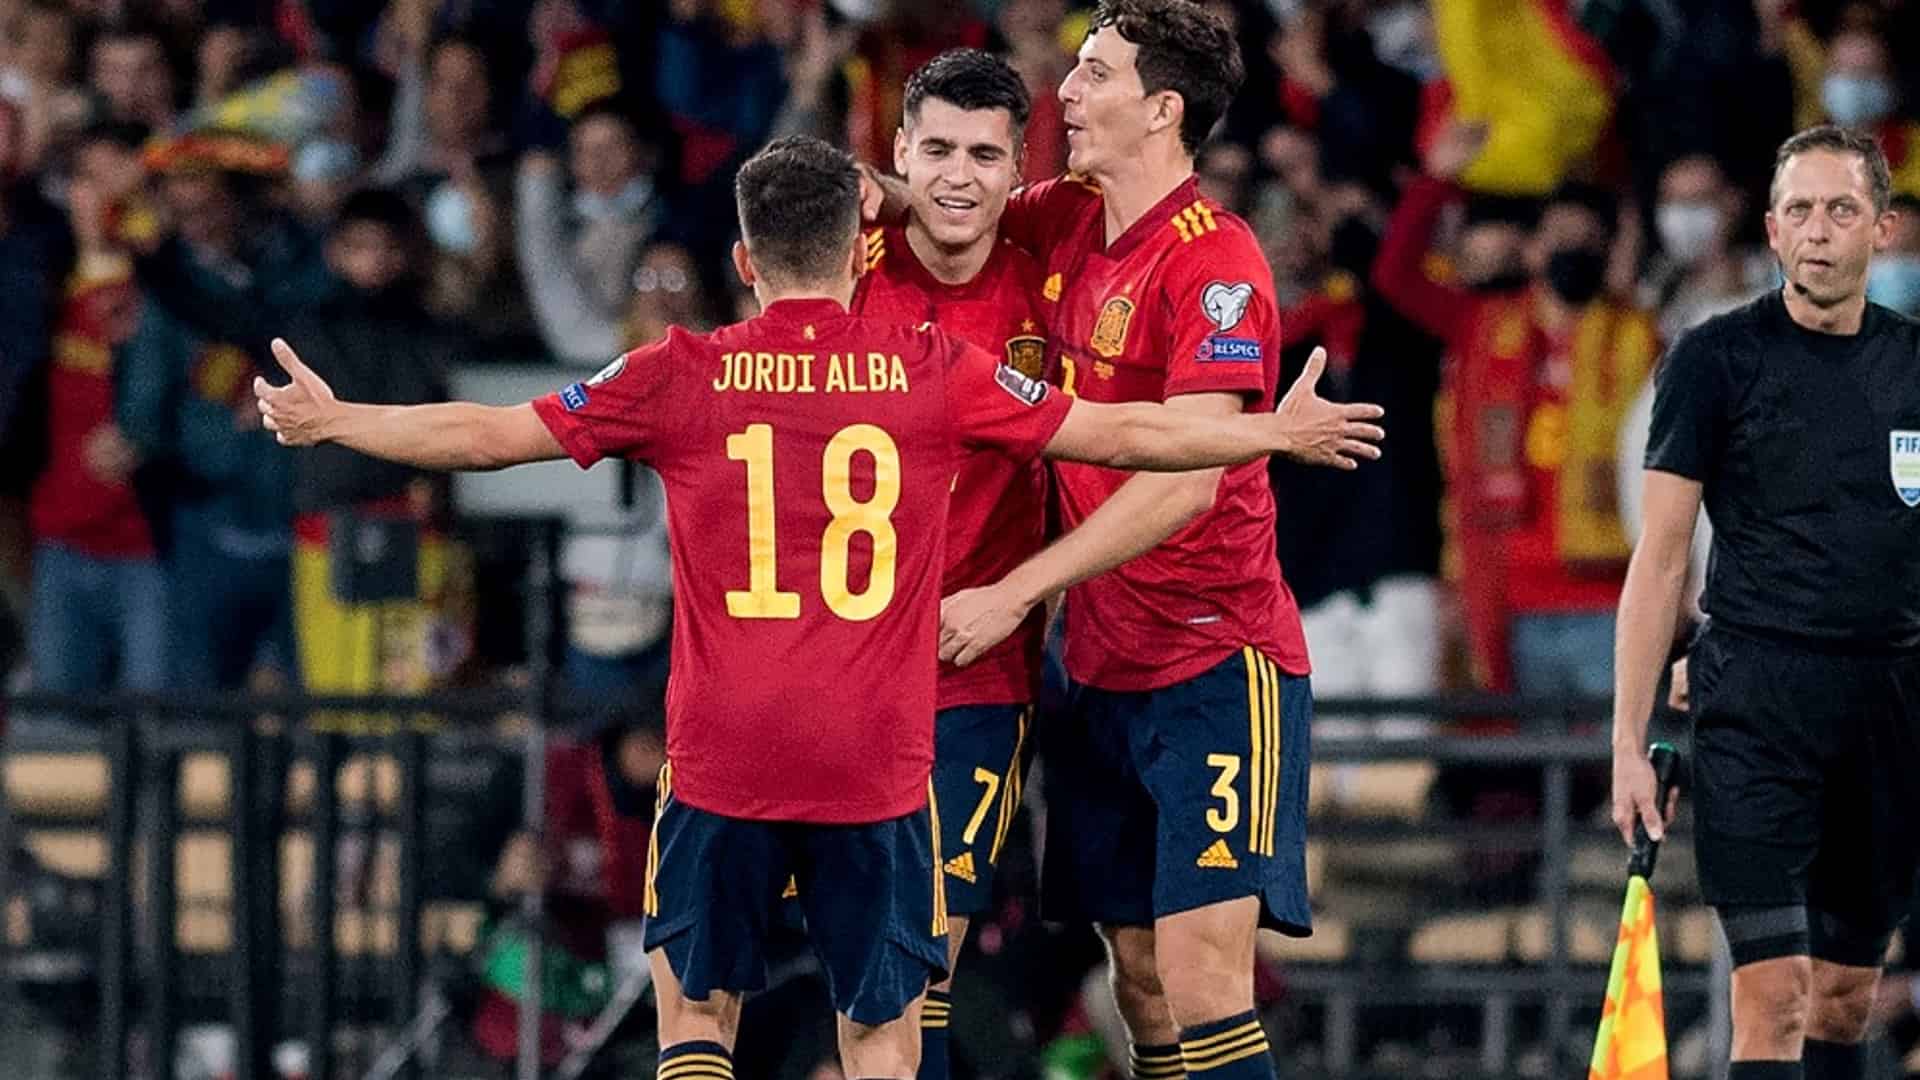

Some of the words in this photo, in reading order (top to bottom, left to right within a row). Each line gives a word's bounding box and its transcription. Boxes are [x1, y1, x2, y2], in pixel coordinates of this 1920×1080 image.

[713, 352, 816, 392] JORDI
[825, 352, 909, 393] ALBA
[1214, 343, 1260, 357] RESPECT
[1896, 437, 1920, 453] FIF
[725, 423, 901, 621] 18
[963, 767, 999, 844] 7
[1206, 753, 1241, 832] 3
